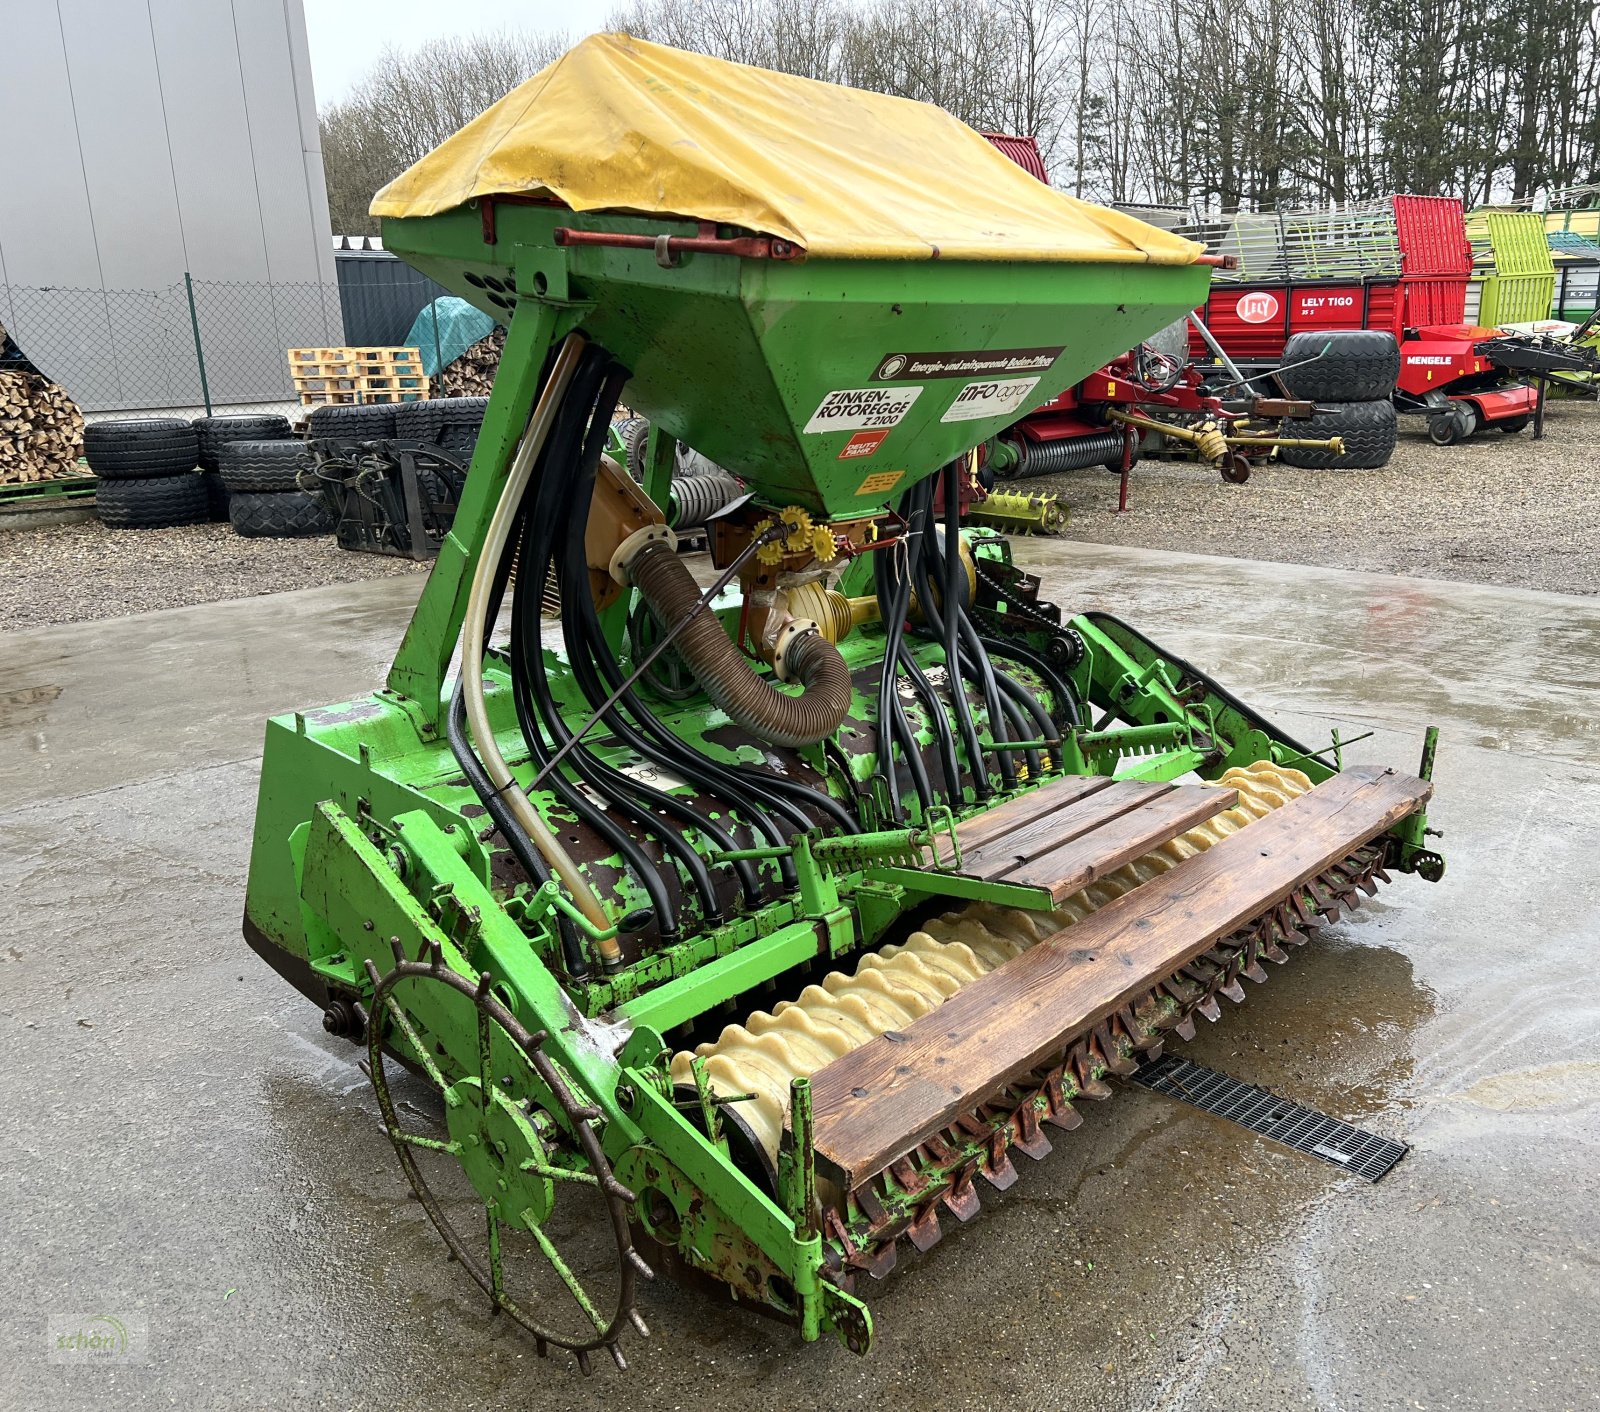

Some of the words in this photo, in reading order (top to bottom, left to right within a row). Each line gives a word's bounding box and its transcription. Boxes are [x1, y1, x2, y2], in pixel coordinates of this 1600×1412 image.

[1244, 299, 1269, 317] LELY
[1301, 298, 1325, 307] LELY
[1327, 297, 1353, 306] TIGO
[959, 357, 1008, 372] zeitsparende
[1407, 356, 1452, 365] MENGELE
[825, 390, 891, 406] ZINKEN-
[996, 383, 1034, 402] agrar
[816, 401, 911, 419] ROTOREGGE
[861, 417, 873, 427] Z
[871, 415, 899, 426] 2100
[845, 448, 871, 456] FAHR
[847, 441, 879, 451] DEUTZ
